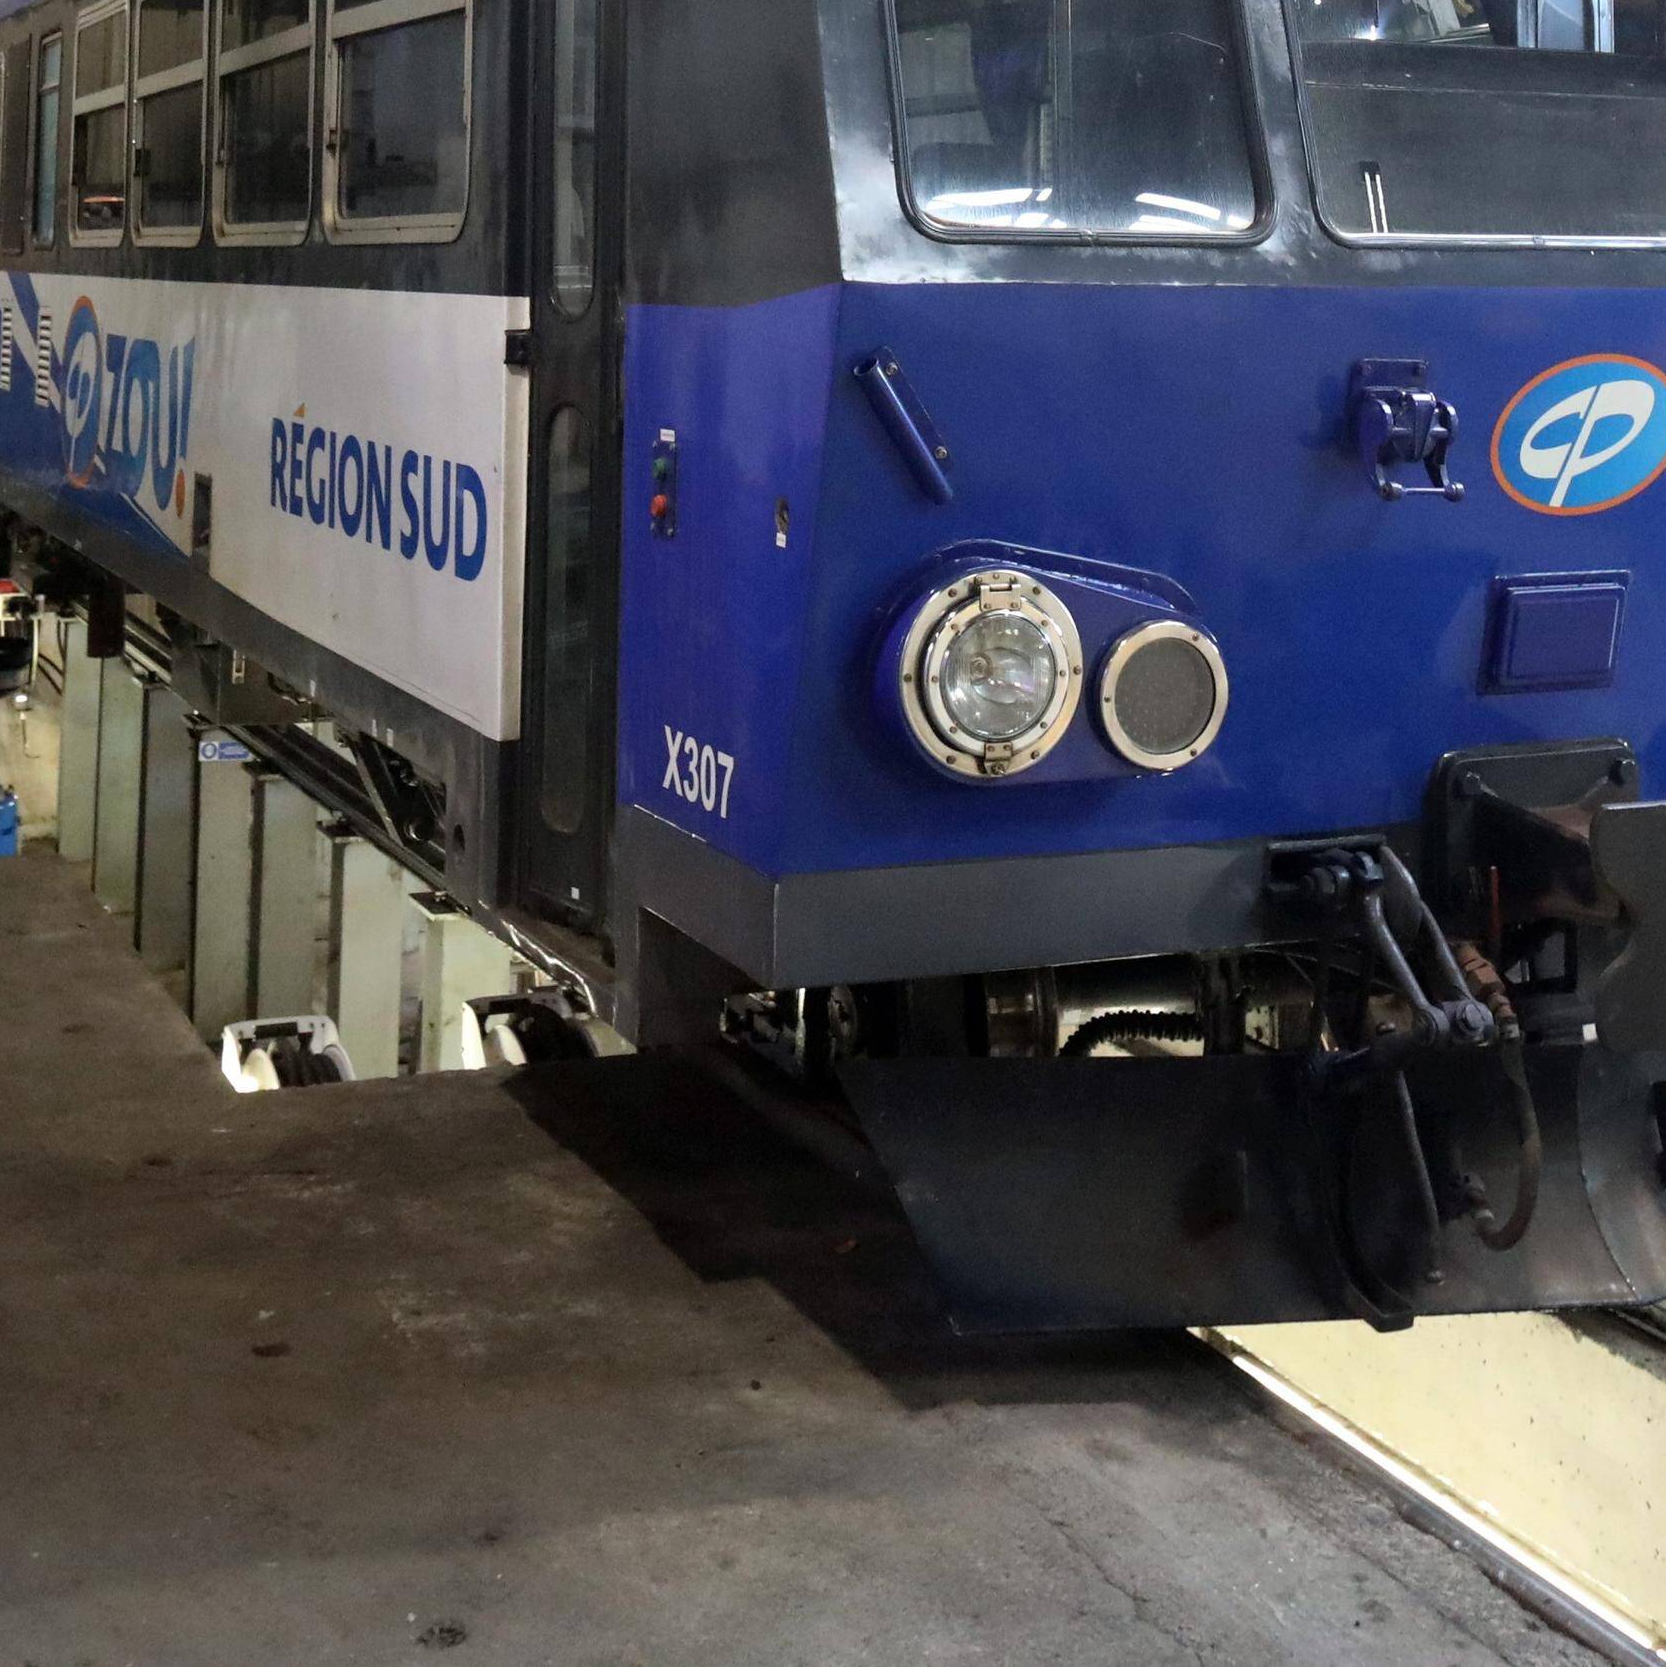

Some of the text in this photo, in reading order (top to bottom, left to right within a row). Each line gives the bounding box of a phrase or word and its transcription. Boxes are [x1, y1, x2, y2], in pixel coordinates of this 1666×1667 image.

[98, 334, 196, 520] ZOU!
[270, 402, 488, 582] RÉGION SUD
[662, 724, 735, 820] X307
